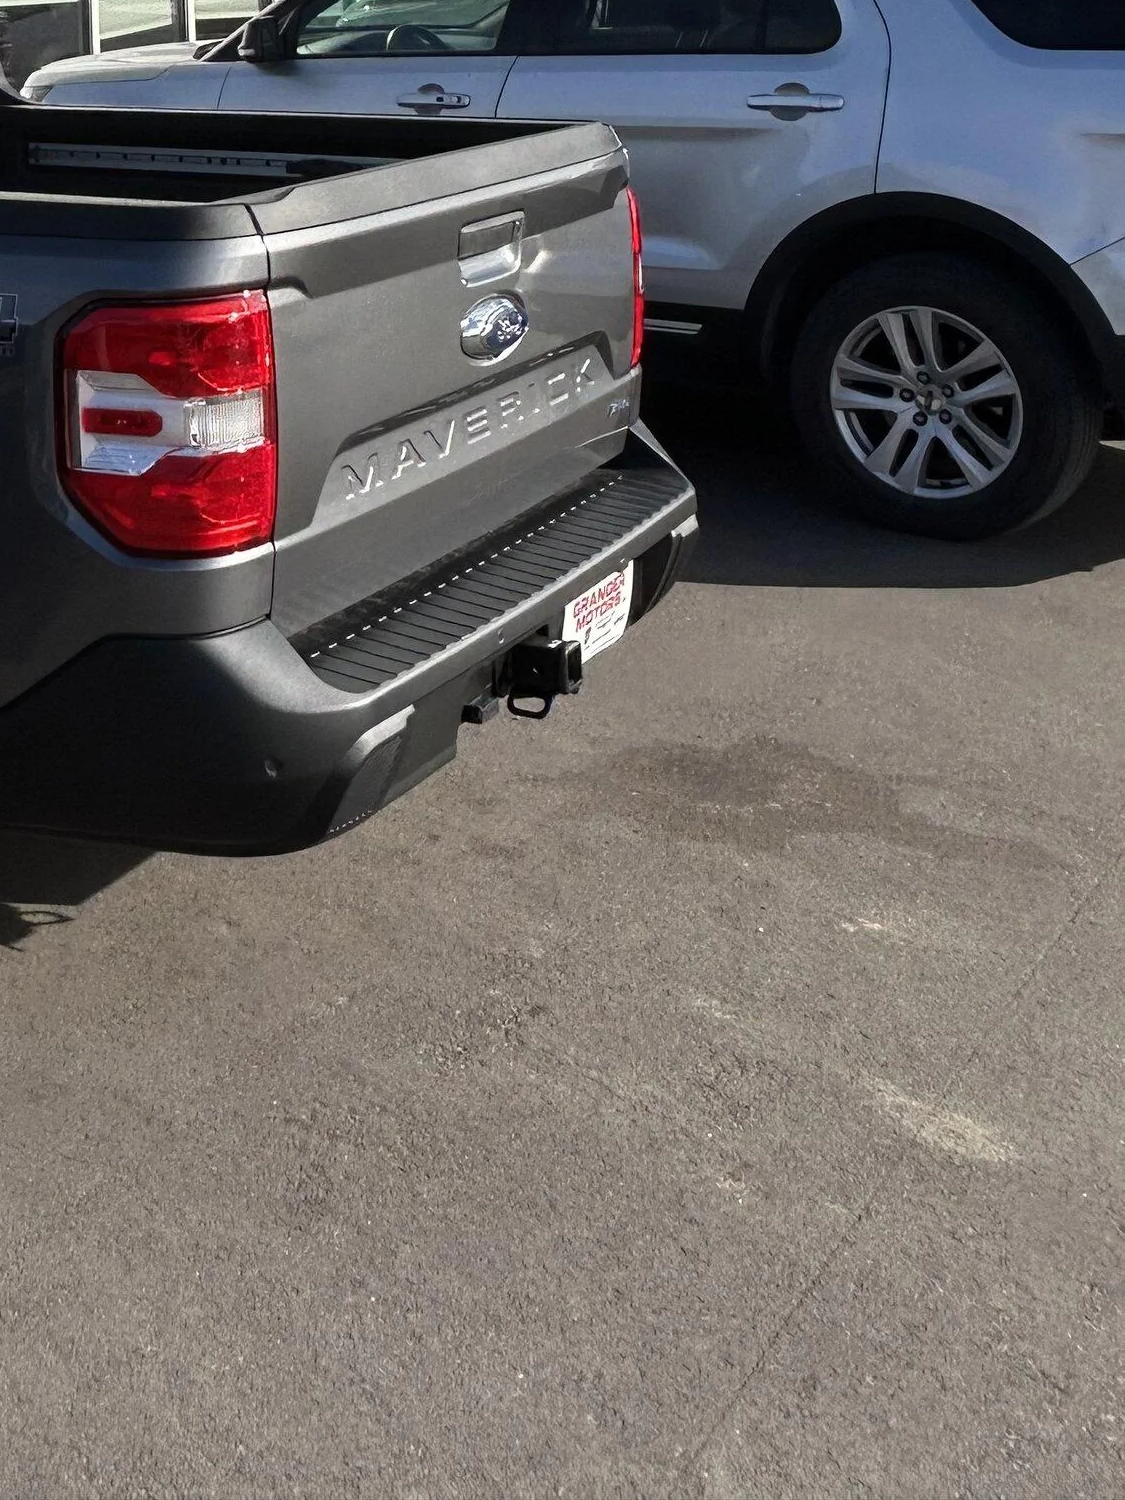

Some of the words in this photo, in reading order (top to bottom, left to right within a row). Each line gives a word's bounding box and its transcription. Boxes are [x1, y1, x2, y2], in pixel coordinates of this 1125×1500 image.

[341, 358, 595, 501] MAVERICK
[573, 572, 626, 619] GRANGER
[576, 591, 622, 633] MOTORS
